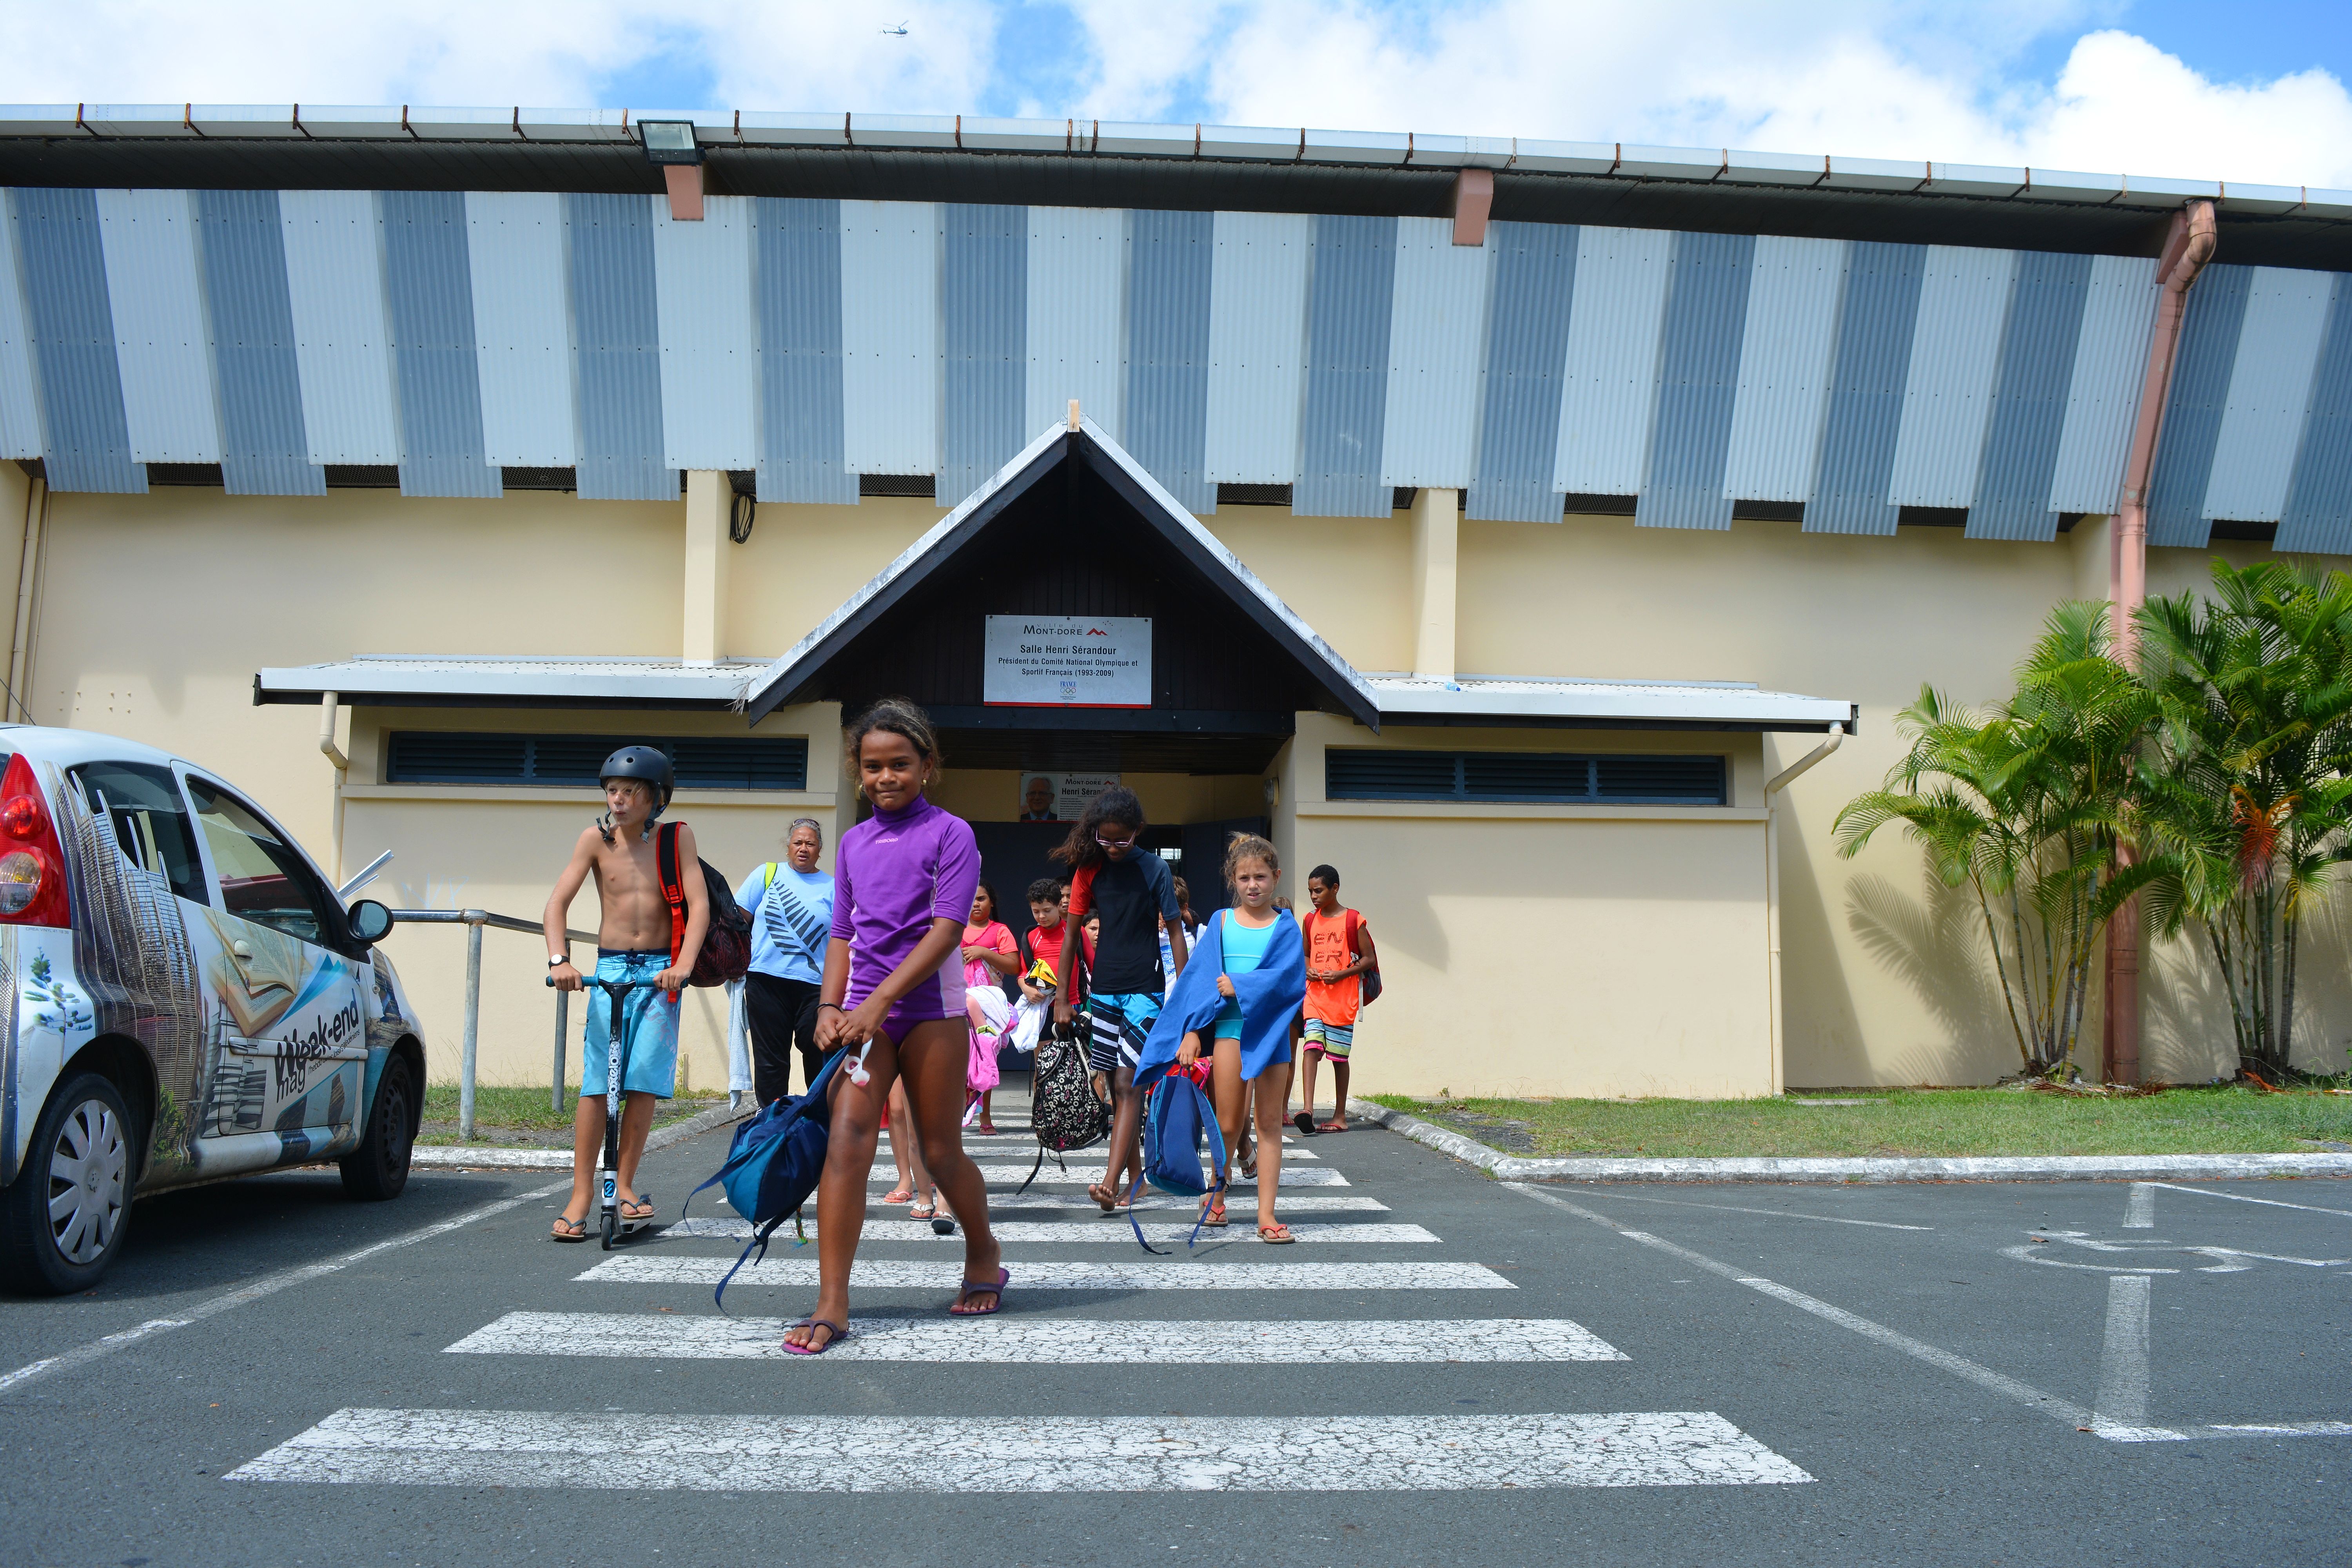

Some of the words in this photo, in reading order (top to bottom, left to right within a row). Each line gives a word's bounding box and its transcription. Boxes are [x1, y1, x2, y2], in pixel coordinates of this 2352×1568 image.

[1024, 625, 1082, 635] MONT-DORE
[1020, 645, 1042, 653] Salle
[1045, 645, 1068, 654] Henri
[1072, 645, 1116, 655] Sérandour
[275, 988, 359, 1086] Week-end
[277, 1068, 307, 1103] mag
